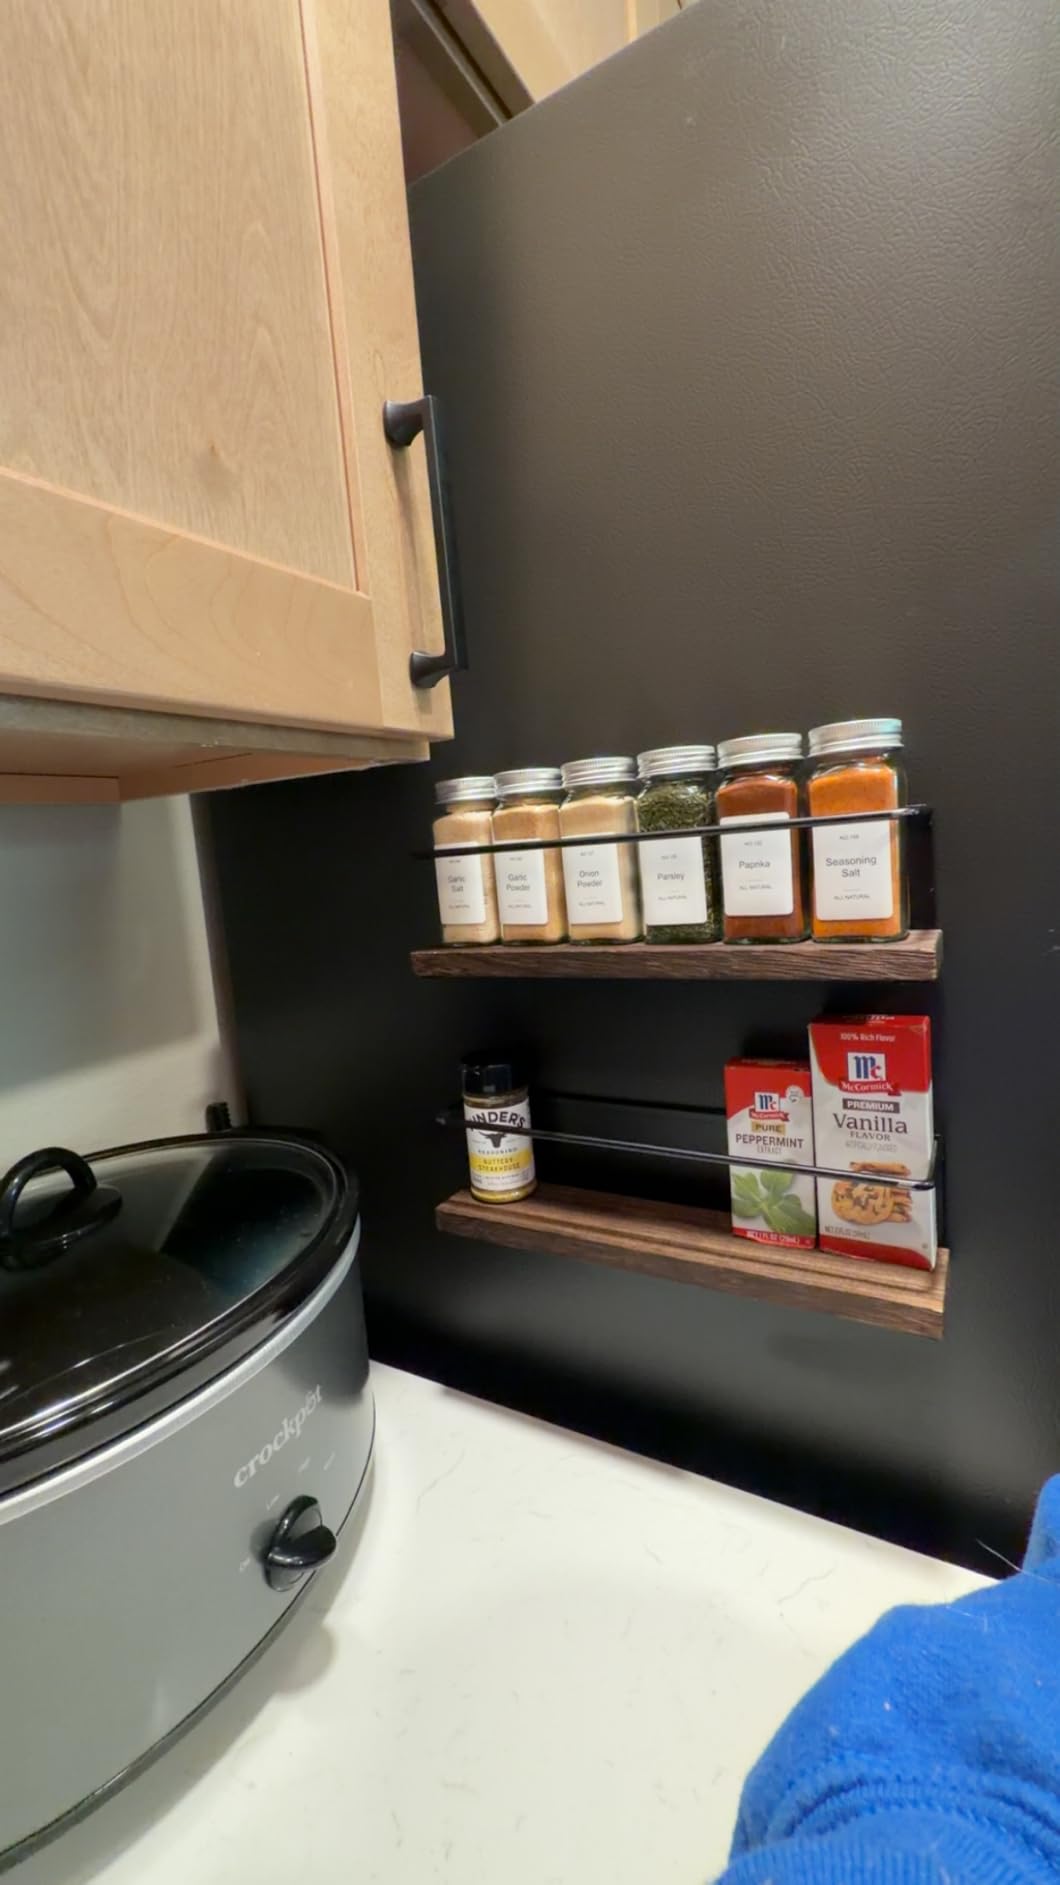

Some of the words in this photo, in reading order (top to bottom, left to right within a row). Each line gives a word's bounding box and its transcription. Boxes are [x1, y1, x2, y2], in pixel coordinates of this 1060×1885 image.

[738, 860, 771, 870] Paprika
[825, 855, 878, 867] Seasoning
[579, 869, 600, 878] Onion
[657, 872, 686, 881] Parsley
[841, 868, 861, 878] Salt
[506, 883, 531, 892] Powder
[577, 879, 603, 888] Powder
[841, 1081, 893, 1092] McCormick
[847, 1100, 894, 1111] PREMIUM
[755, 1123, 782, 1133] PURE
[833, 1112, 908, 1134] Vanilla
[735, 1133, 804, 1148] PEPPERMINT
[850, 1131, 891, 1142] FLAVOR
